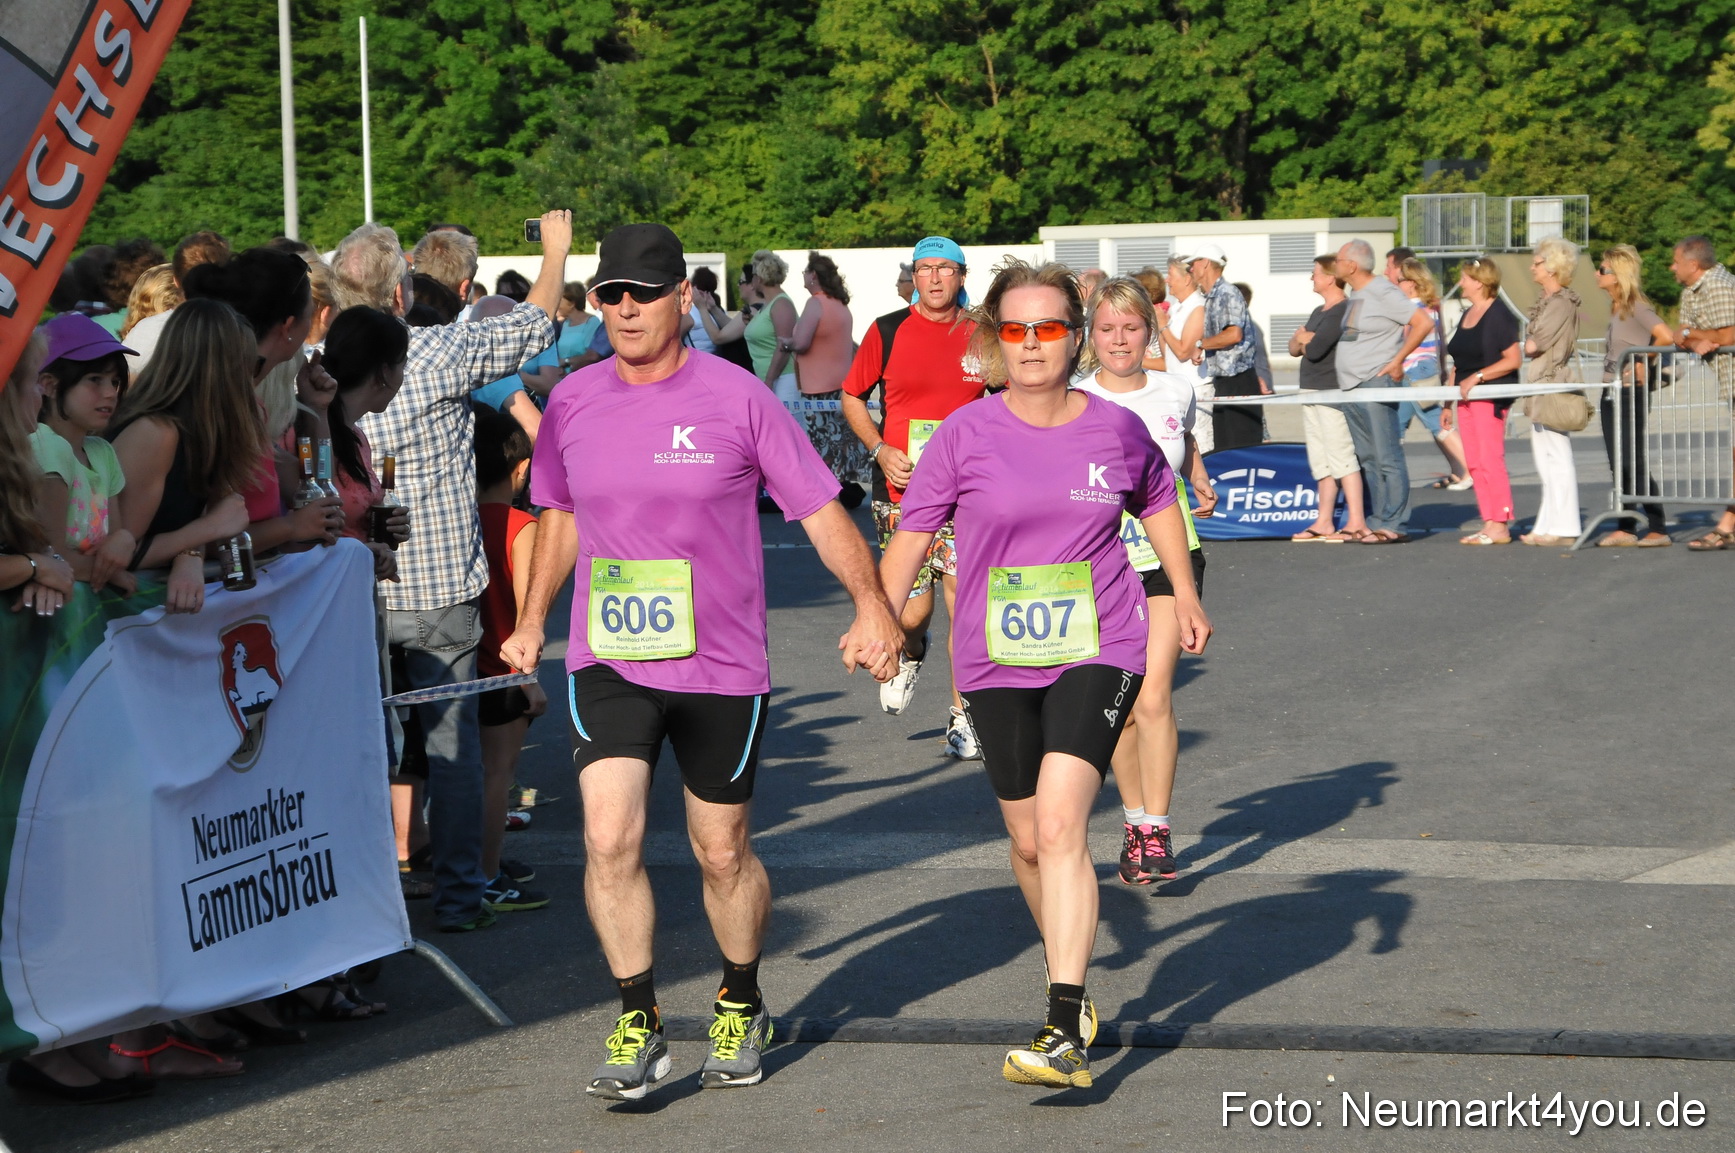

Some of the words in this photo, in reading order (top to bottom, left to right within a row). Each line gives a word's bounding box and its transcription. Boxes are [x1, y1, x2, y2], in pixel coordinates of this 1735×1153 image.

[672, 425, 697, 450] K
[654, 451, 715, 459] KÜFNER
[1088, 462, 1111, 489] K
[1070, 488, 1121, 501] KÜFNER
[1227, 484, 1345, 511] Fisch
[1238, 509, 1342, 523] AUTOMOBE
[600, 594, 675, 635] 606
[1001, 598, 1076, 641] 607
[191, 787, 305, 865] Neumarkter
[180, 838, 339, 952] Lammsbräu
